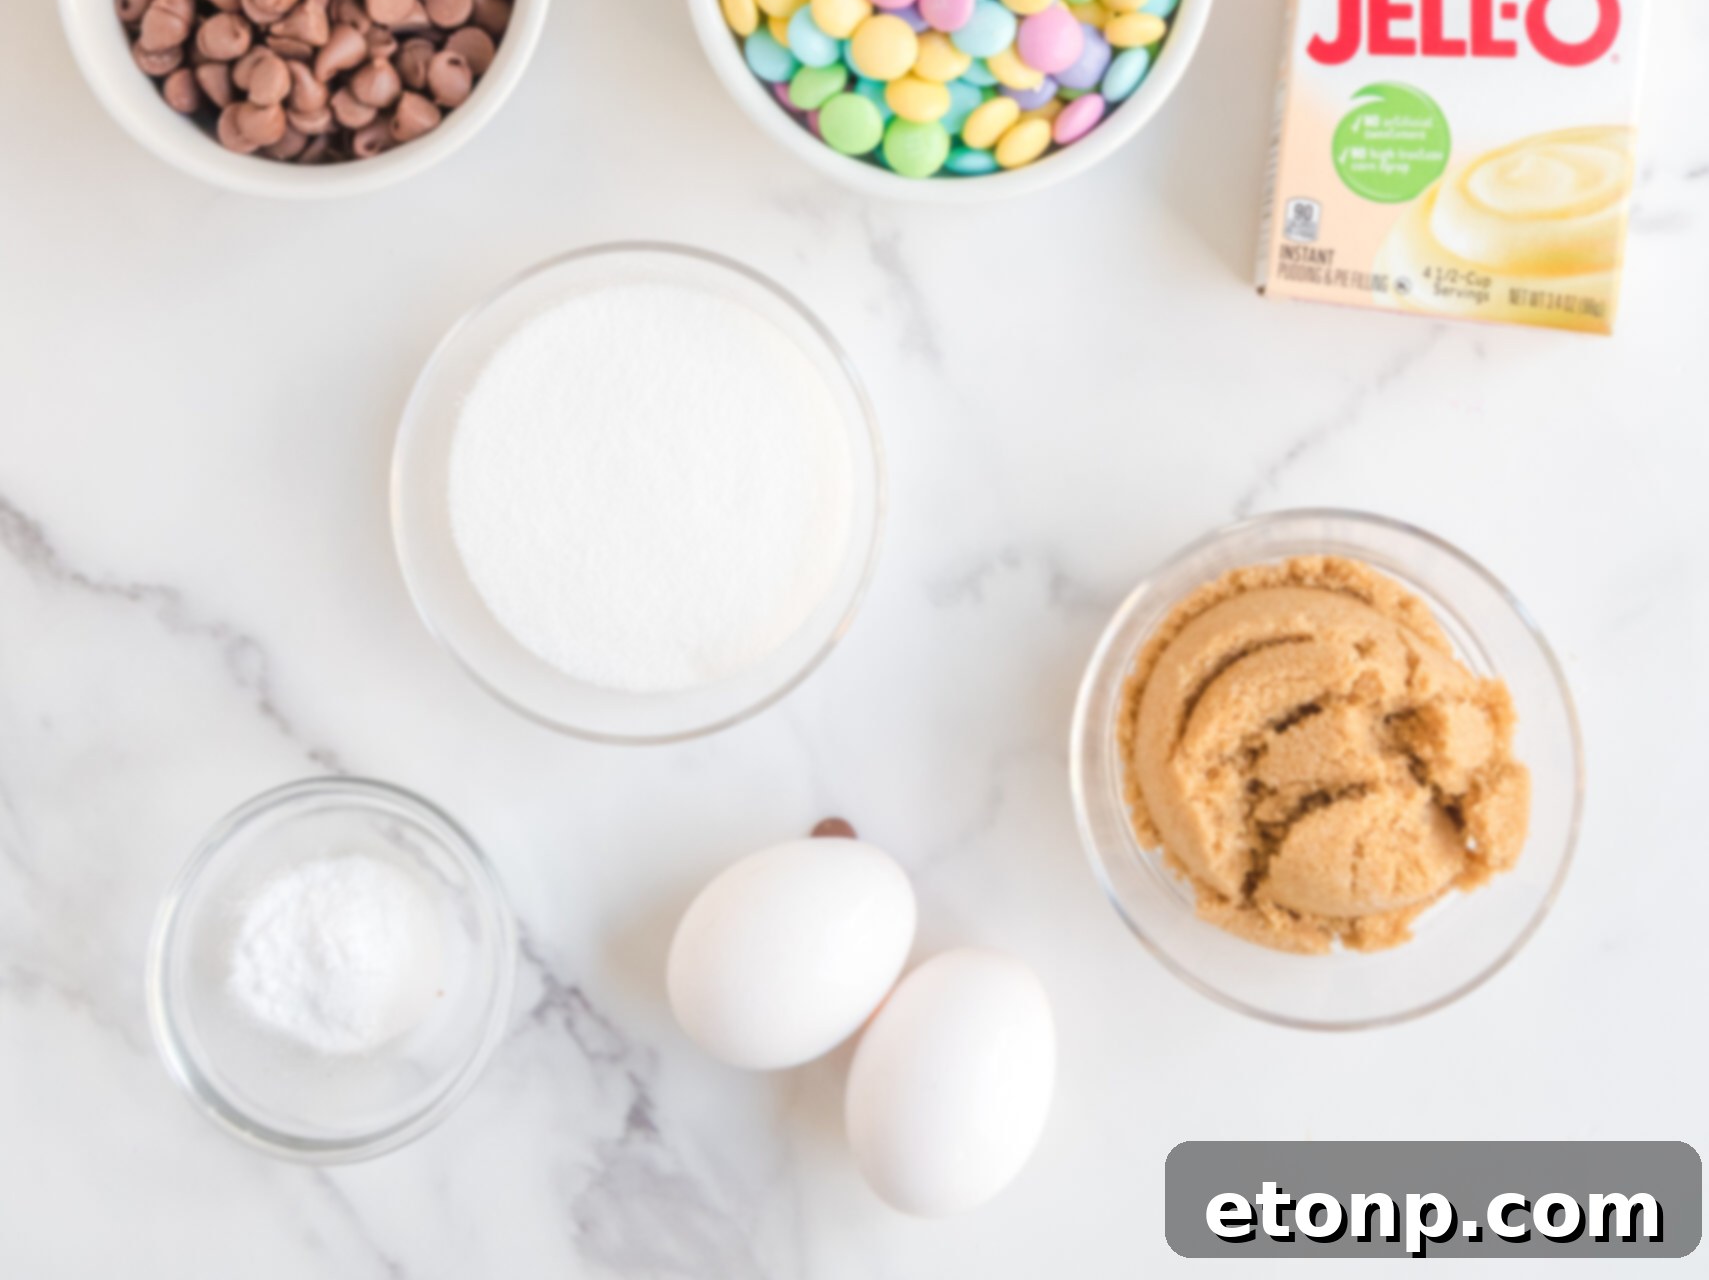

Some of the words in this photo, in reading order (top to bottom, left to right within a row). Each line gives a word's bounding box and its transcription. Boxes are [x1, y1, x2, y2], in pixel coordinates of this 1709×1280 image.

[1279, 244, 1335, 265] INSTANT
[1422, 266, 1432, 279] 4
[1435, 267, 1492, 289] 1/2-Cup
[1433, 283, 1490, 305] Servings
